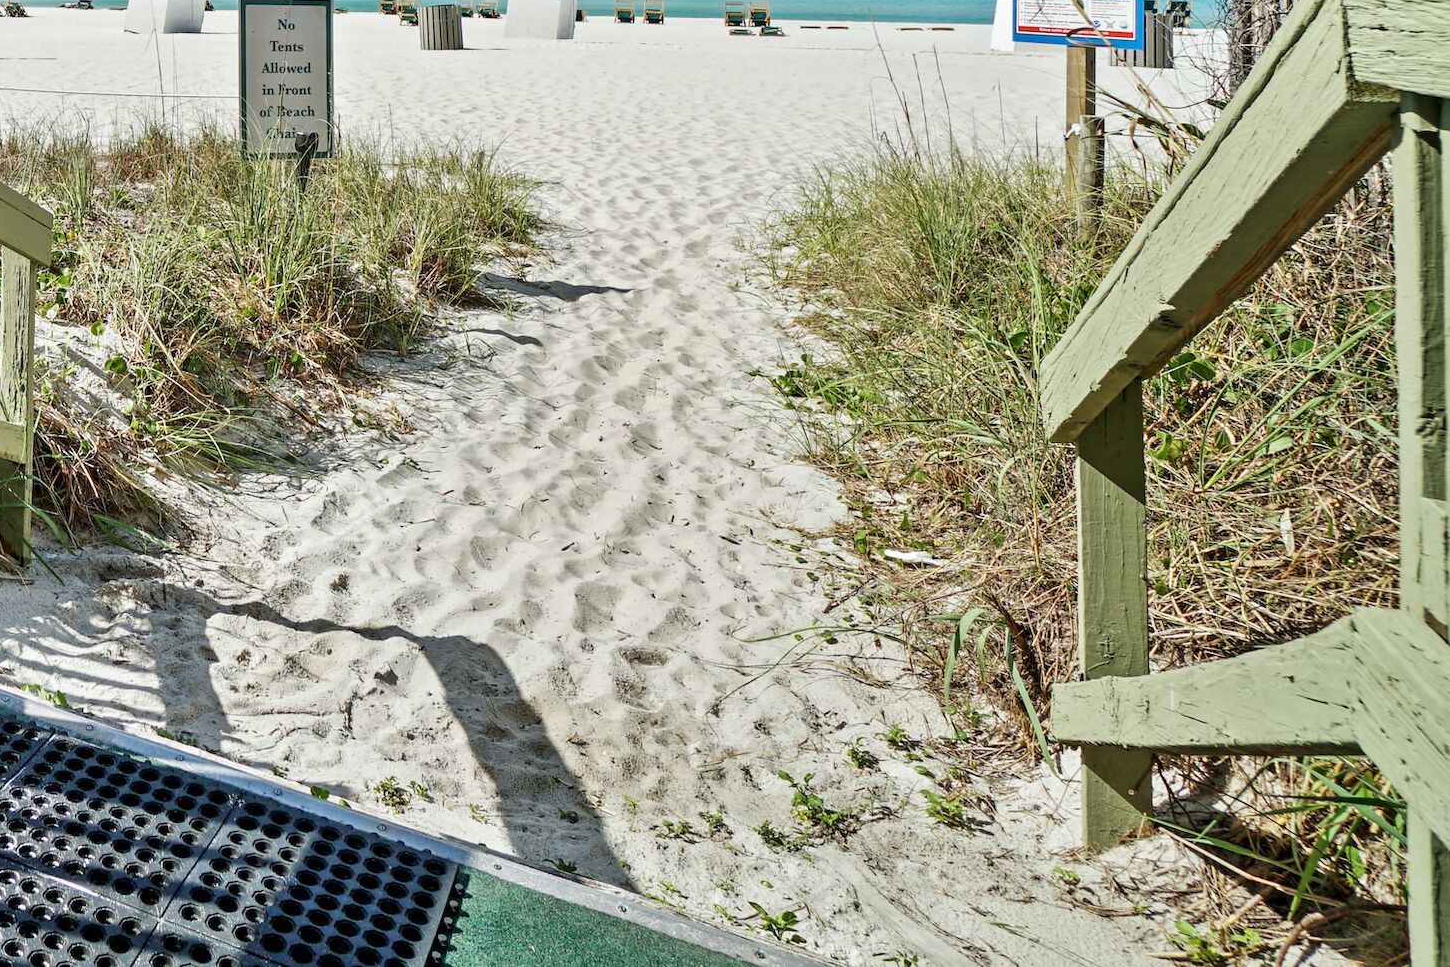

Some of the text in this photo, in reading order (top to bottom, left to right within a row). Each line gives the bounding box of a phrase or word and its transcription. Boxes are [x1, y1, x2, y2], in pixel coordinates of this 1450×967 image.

[278, 19, 295, 30] No
[270, 41, 303, 52] Tents
[262, 63, 311, 74] Allowed
[262, 84, 312, 95] in Front
[260, 105, 315, 117] of Beach
